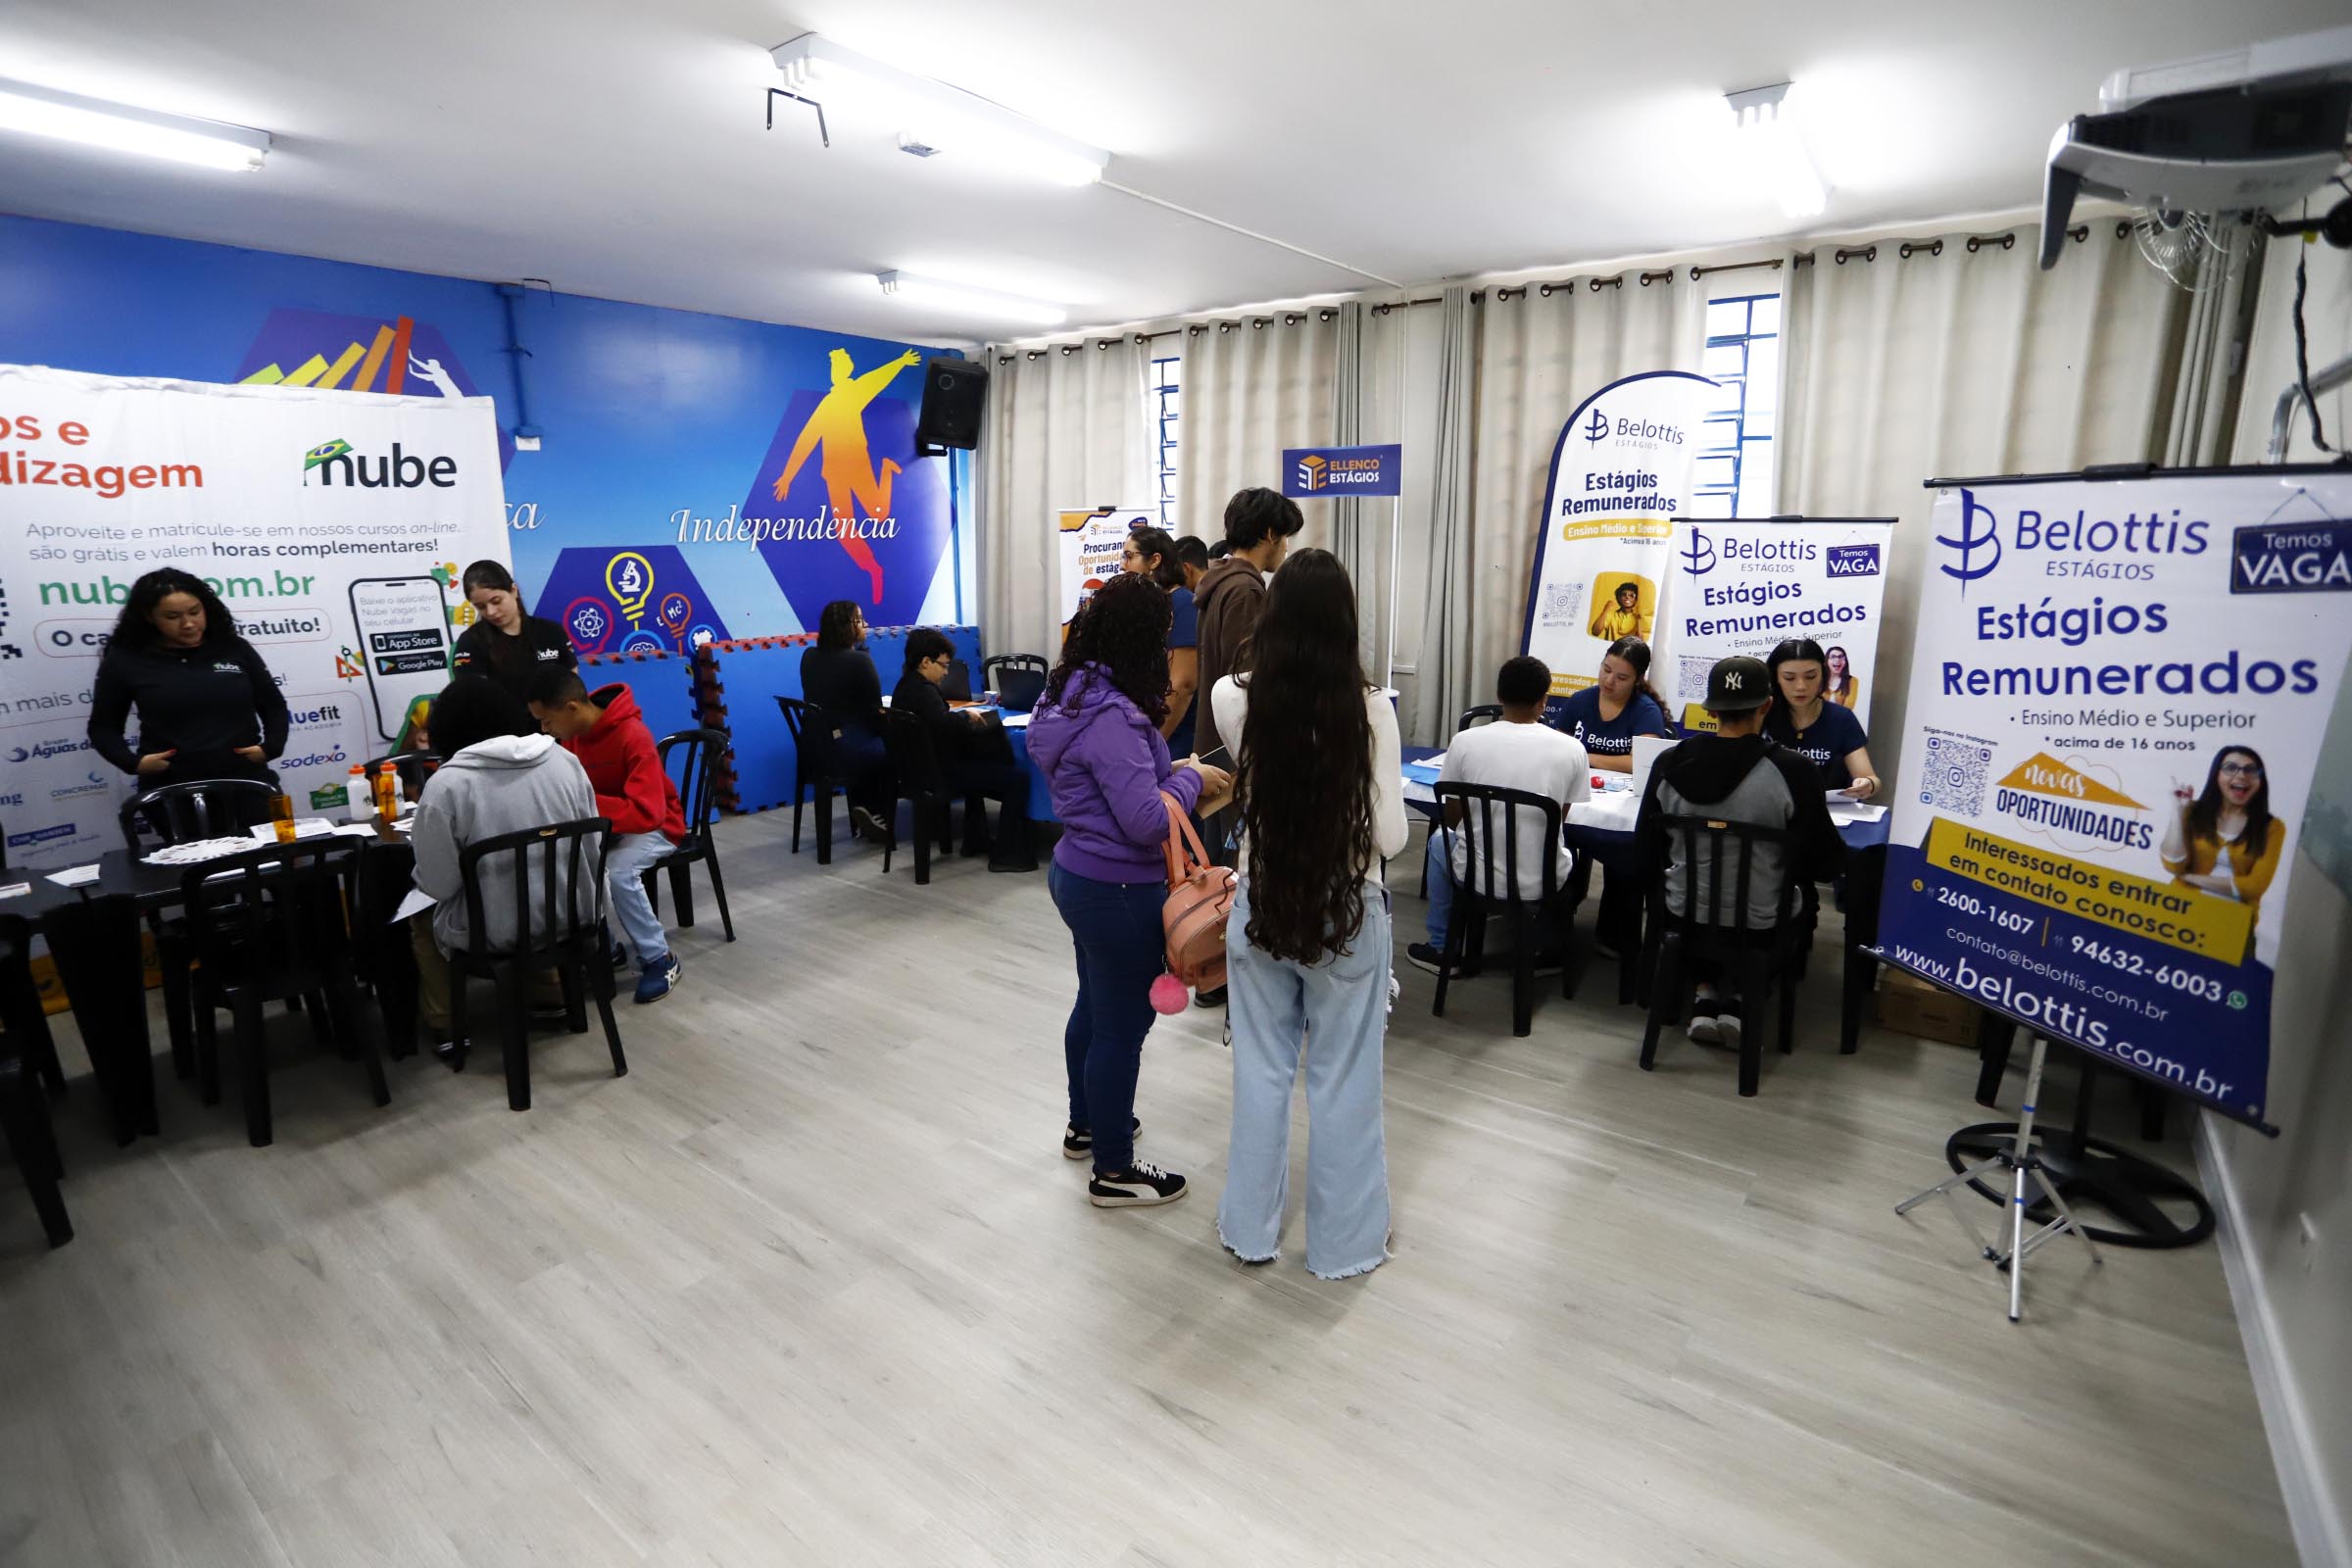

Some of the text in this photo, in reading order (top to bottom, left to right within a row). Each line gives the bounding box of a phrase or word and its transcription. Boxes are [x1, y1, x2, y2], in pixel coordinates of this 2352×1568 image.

[58, 421, 90, 446] e
[1617, 417, 1685, 445] Belottis
[320, 442, 458, 488] nube
[1329, 470, 1380, 483] ESTÁGIOS
[1330, 459, 1380, 471] ELLENCO
[1586, 468, 1658, 493] Estágios
[1562, 492, 1677, 516] Remunerados
[25, 522, 126, 540] Aproveite
[131, 528, 144, 539] e
[148, 522, 263, 538] matricule-se
[267, 525, 294, 537] em
[298, 524, 353, 537] nossos
[357, 524, 407, 536] cursos
[670, 505, 901, 552] Independência
[2015, 509, 2210, 555] Belottis
[28, 538, 439, 564] são grátis e valem horas complementares!
[1724, 538, 1817, 561] Belottis
[2263, 532, 2332, 550] Temos
[1838, 549, 1869, 558] Temos
[1083, 564, 1095, 576] de
[1740, 563, 1794, 572] ESTÁGIOS
[1829, 558, 1878, 574] VAGA
[2045, 560, 2155, 581] ESTÁGIOS
[2239, 550, 2352, 585] VAGA
[1704, 581, 1802, 607] Estágios
[235, 617, 320, 636] ratuito!
[1686, 603, 1866, 637] Remunerados
[1978, 596, 2168, 647] Estágios
[51, 630, 73, 647] O
[389, 637, 438, 650] App Store
[1734, 639, 1763, 649] Ensino
[398, 659, 444, 671] Google Play
[1941, 651, 2320, 697] Remunerados
[16, 691, 73, 712] mais
[288, 706, 341, 724] luefit
[2022, 709, 2257, 732] Ensino Médio e Superior
[32, 741, 78, 759] Águas
[1588, 733, 1632, 748] Belottis
[2053, 736, 2196, 752] acima de 16 anos
[280, 751, 346, 769] sodexo
[2025, 763, 2085, 798] novas
[1996, 788, 2154, 850] OPORTUNIDADES
[1965, 832, 2192, 914] Interessados entrar
[1937, 886, 2034, 934] 2600-1607
[1949, 855, 2207, 949] em contato conosco:
[1946, 927, 2170, 1021] contato@belottis.com.br
[2071, 935, 2223, 1002] 94632-6003
[1895, 945, 2233, 1100] www.belottis.com.br
